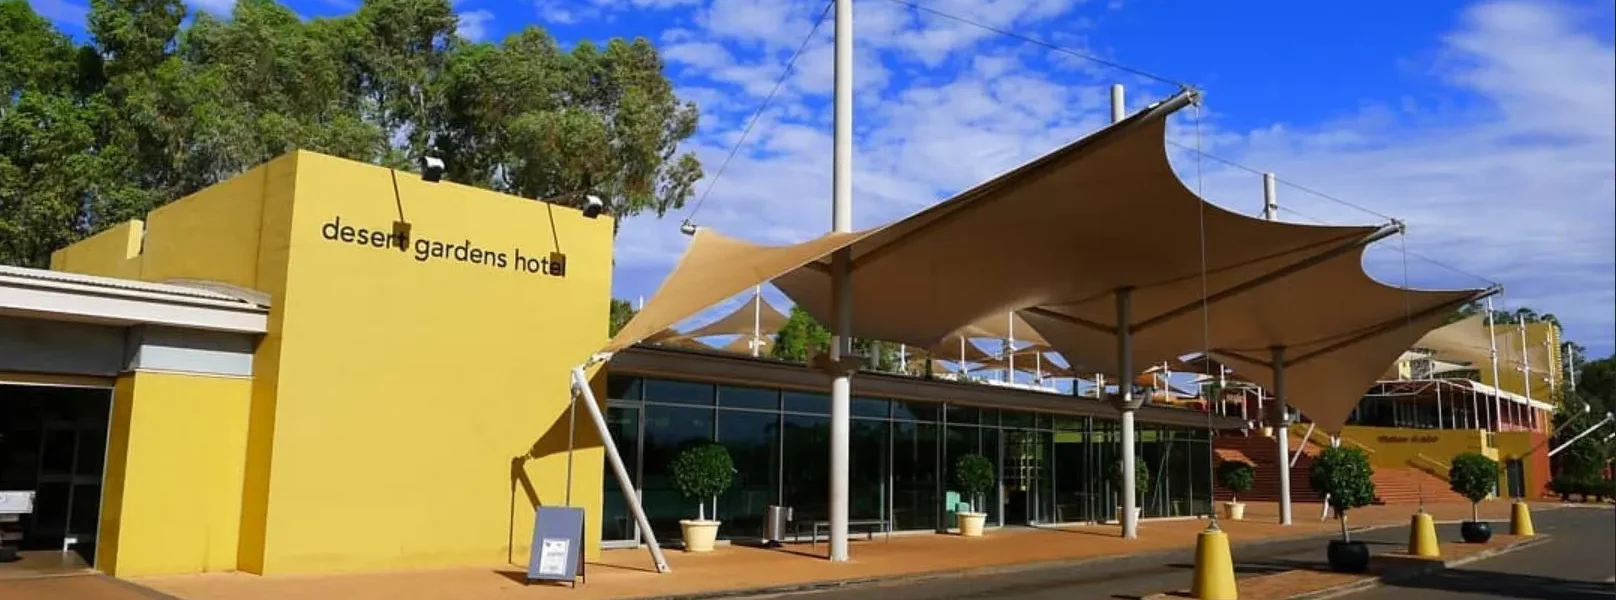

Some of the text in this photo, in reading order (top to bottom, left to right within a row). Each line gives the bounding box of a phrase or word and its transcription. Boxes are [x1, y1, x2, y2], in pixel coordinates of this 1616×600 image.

[322, 216, 566, 277] desert gardens hotel
